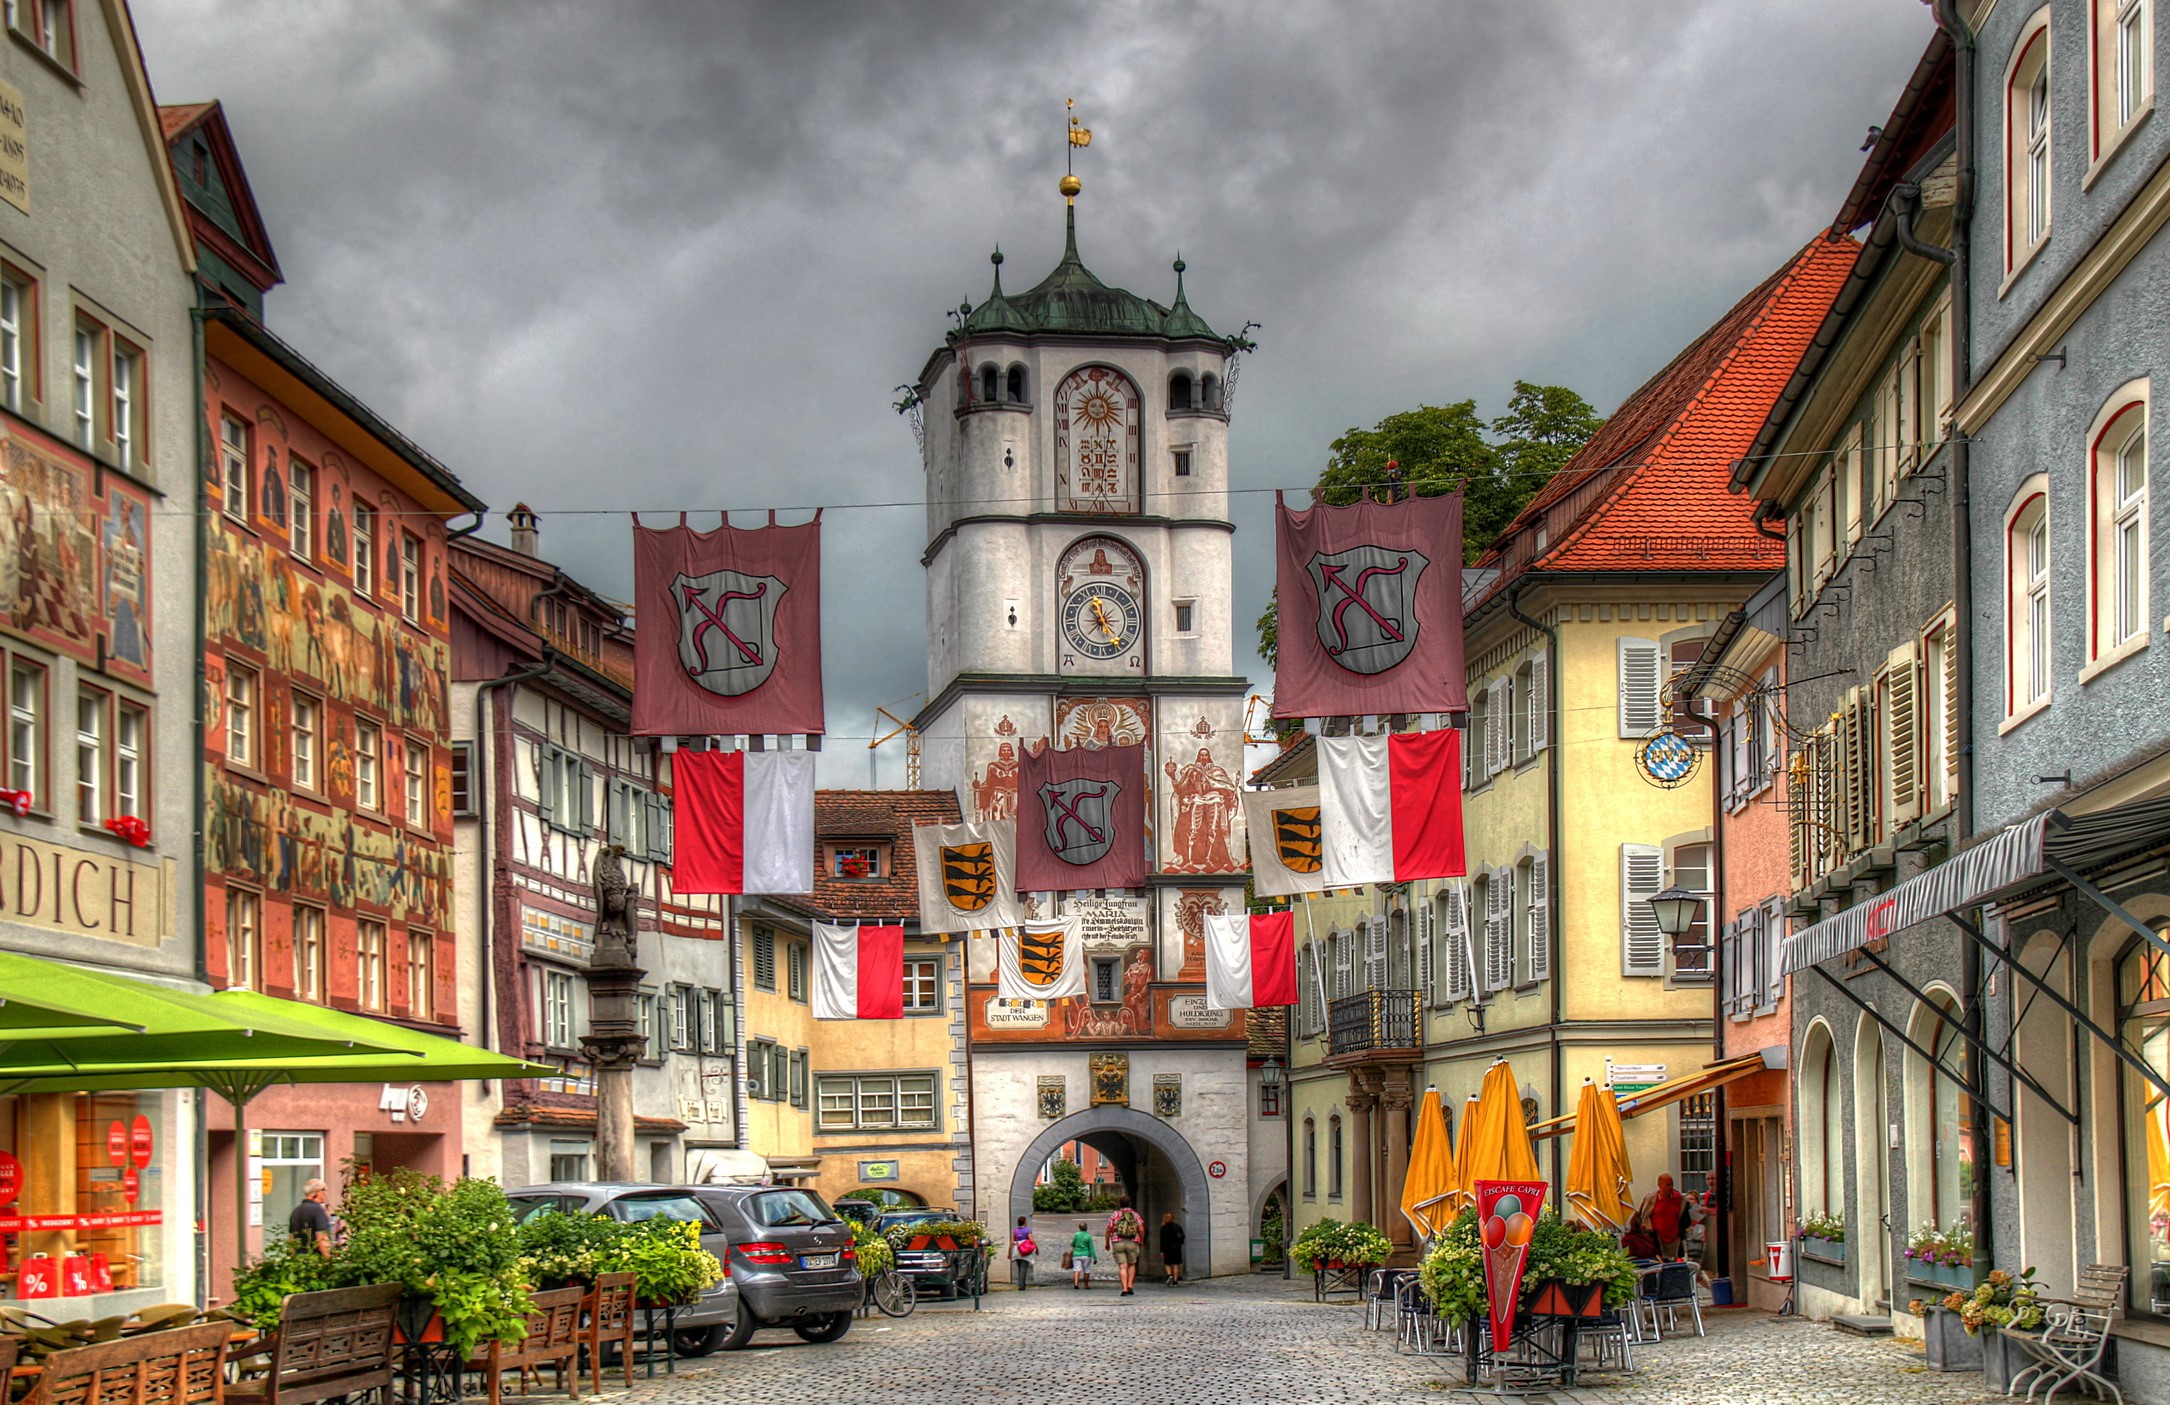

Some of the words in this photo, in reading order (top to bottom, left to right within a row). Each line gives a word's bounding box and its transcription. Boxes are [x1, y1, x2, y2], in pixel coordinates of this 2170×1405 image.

[1129, 453, 1136, 463] II
[1059, 473, 1067, 485] X
[1068, 501, 1078, 511] XI
[0, 843, 135, 937] DICH
[1073, 899, 1102, 910] Heilige
[1102, 899, 1138, 910] Jungfrau
[990, 1014, 1011, 1022] STADT
[1484, 1185, 1515, 1197] EISCAFE
[1517, 1185, 1540, 1197] CAPRI
[26, 1273, 48, 1294] %
